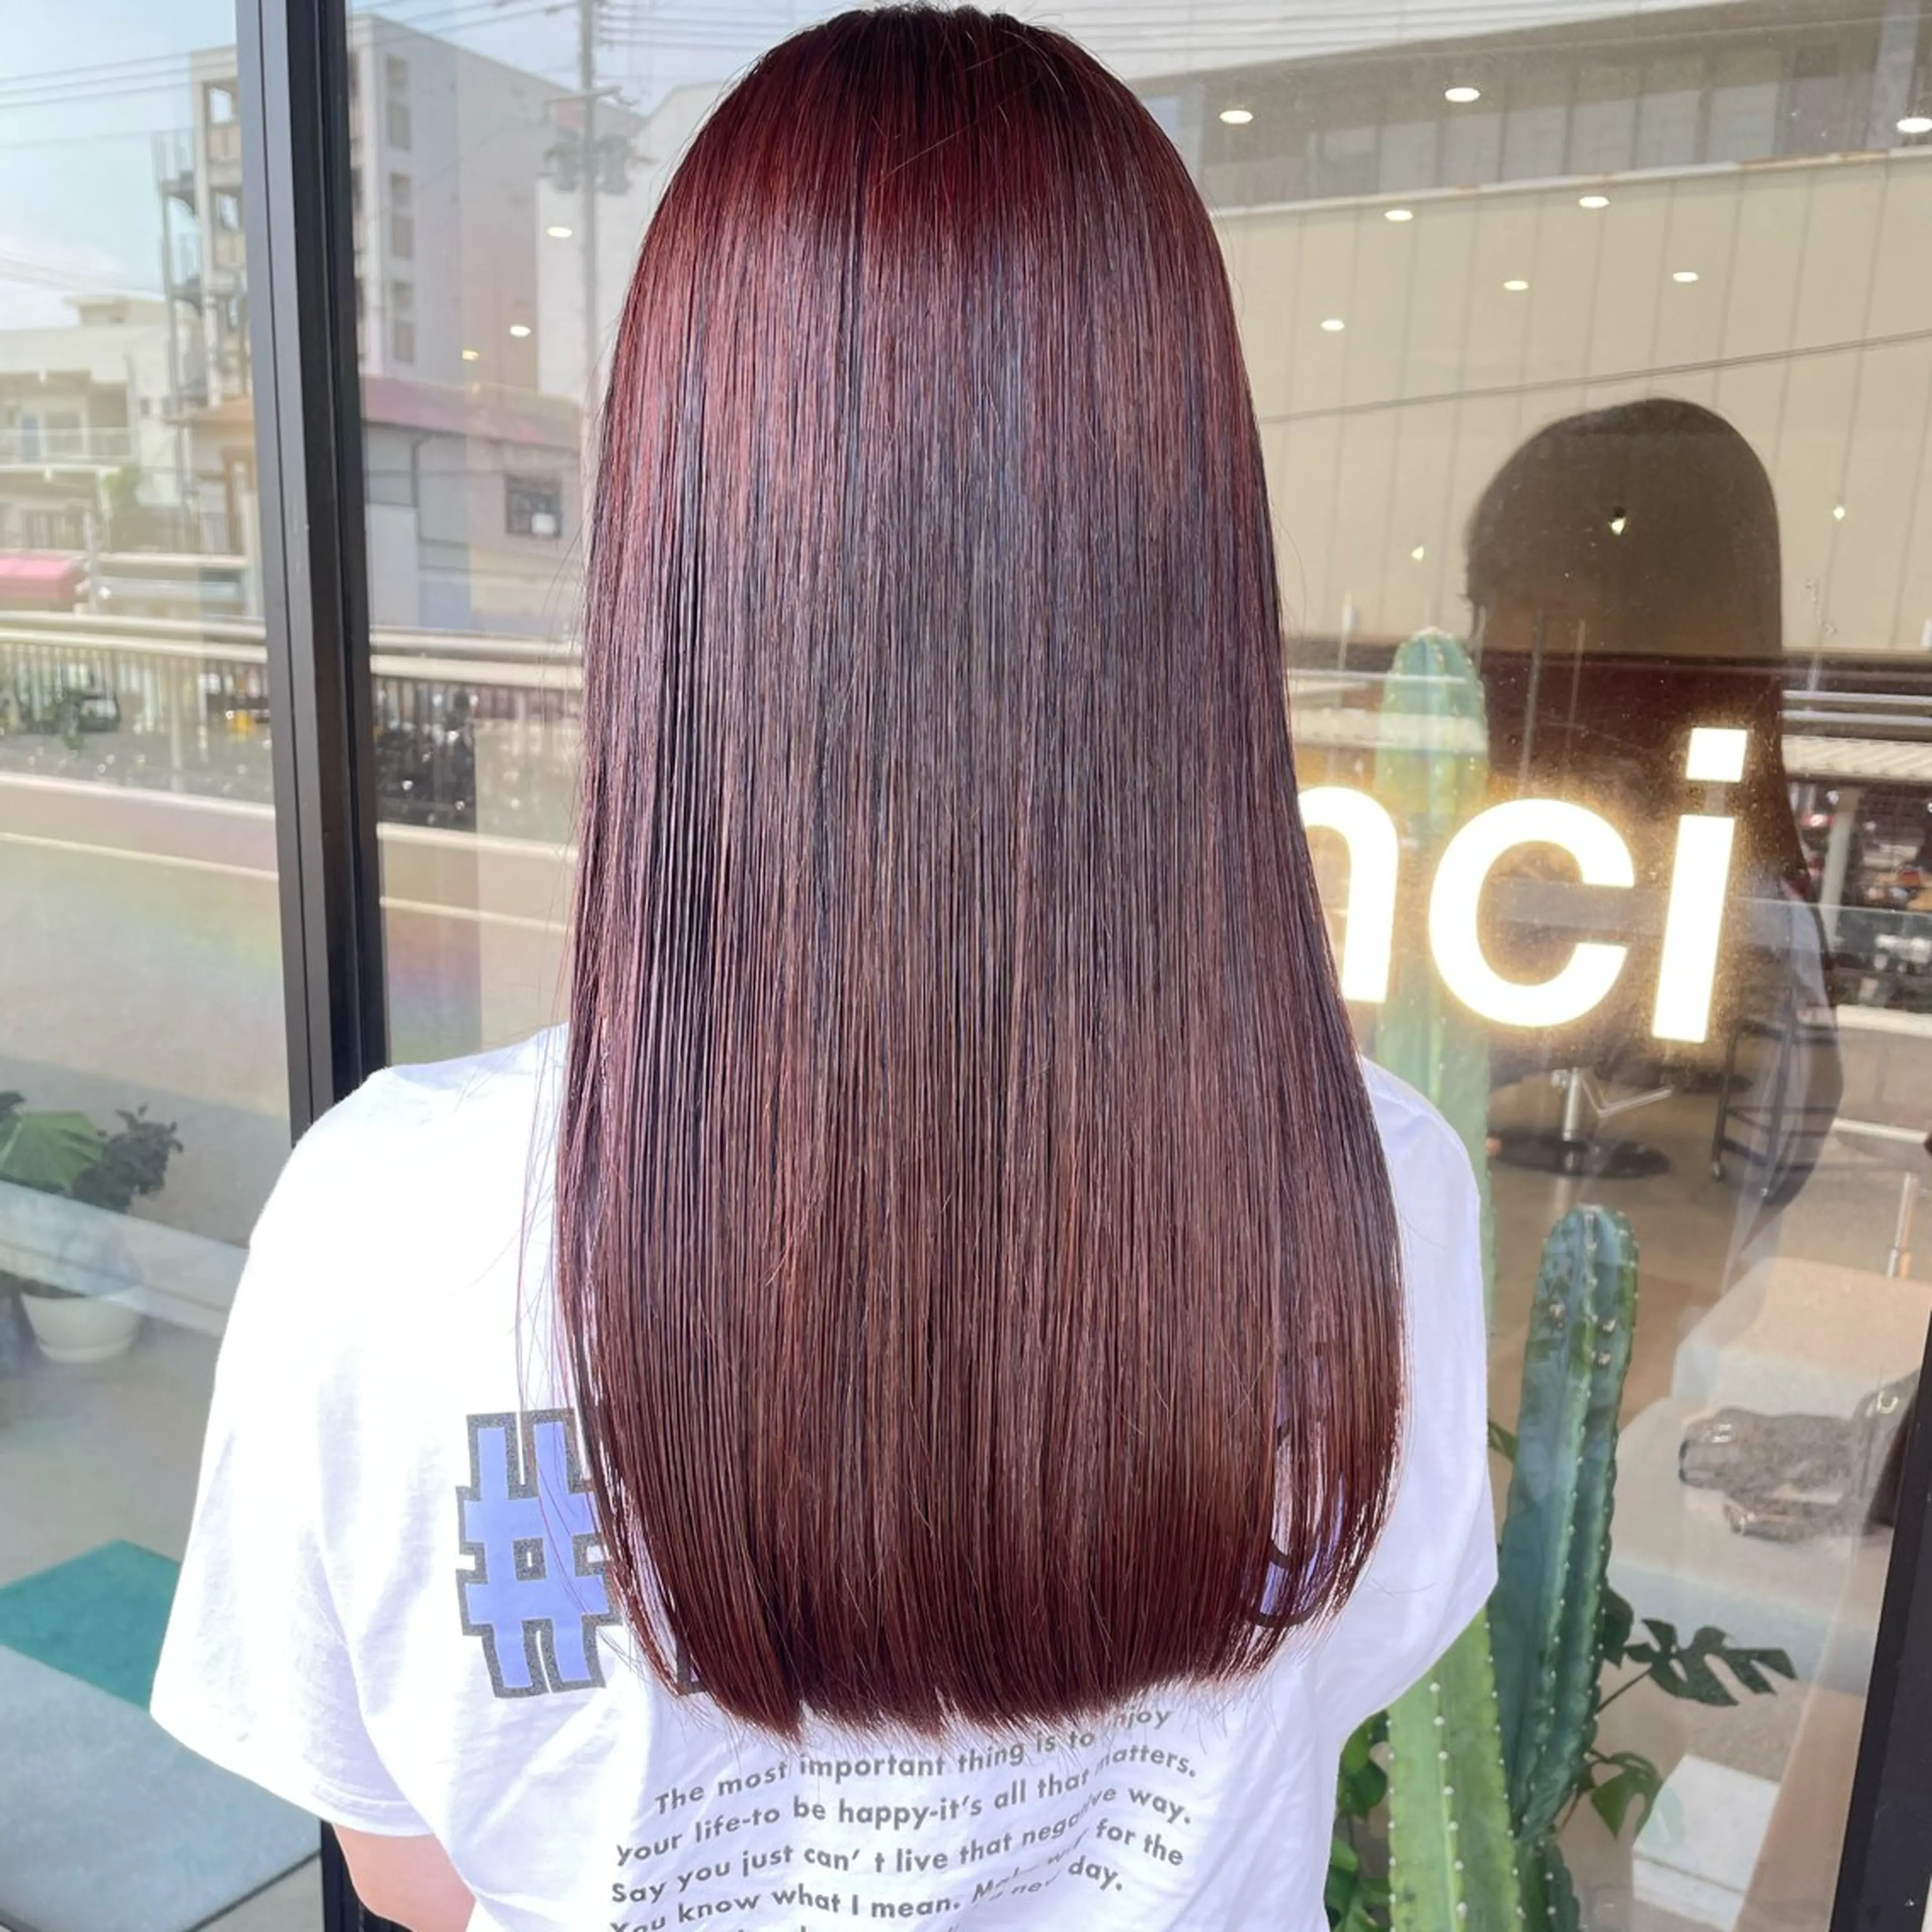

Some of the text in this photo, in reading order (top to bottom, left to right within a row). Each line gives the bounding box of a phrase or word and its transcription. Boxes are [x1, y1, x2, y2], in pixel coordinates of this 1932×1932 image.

[617, 1832, 683, 1866] your
[695, 1808, 780, 1843] life-to
[794, 1796, 826, 1820] be
[839, 1796, 982, 1830] happy-it's
[995, 1779, 1026, 1810] all
[1037, 1767, 1089, 1799] that
[656, 1785, 704, 1814] The
[718, 1760, 788, 1797] most
[800, 1753, 945, 1784] important
[958, 1743, 1025, 1773] thing
[1036, 1731, 1056, 1753] is
[1069, 1731, 1095, 1749] to
[612, 1882, 667, 1904] Say
[677, 1862, 730, 1892] you
[742, 1844, 793, 1878] just
[896, 1848, 948, 1873] live
[959, 1835, 1012, 1866] that
[1129, 1788, 1190, 1824] way.
[679, 1894, 761, 1922] know
[771, 1883, 840, 1913] what
[852, 1894, 858, 1915] I
[871, 1898, 960, 1918] mean.
[1096, 1818, 1136, 1845] for
[1144, 1833, 1183, 1866] the
[1068, 1855, 1122, 1891] day.
